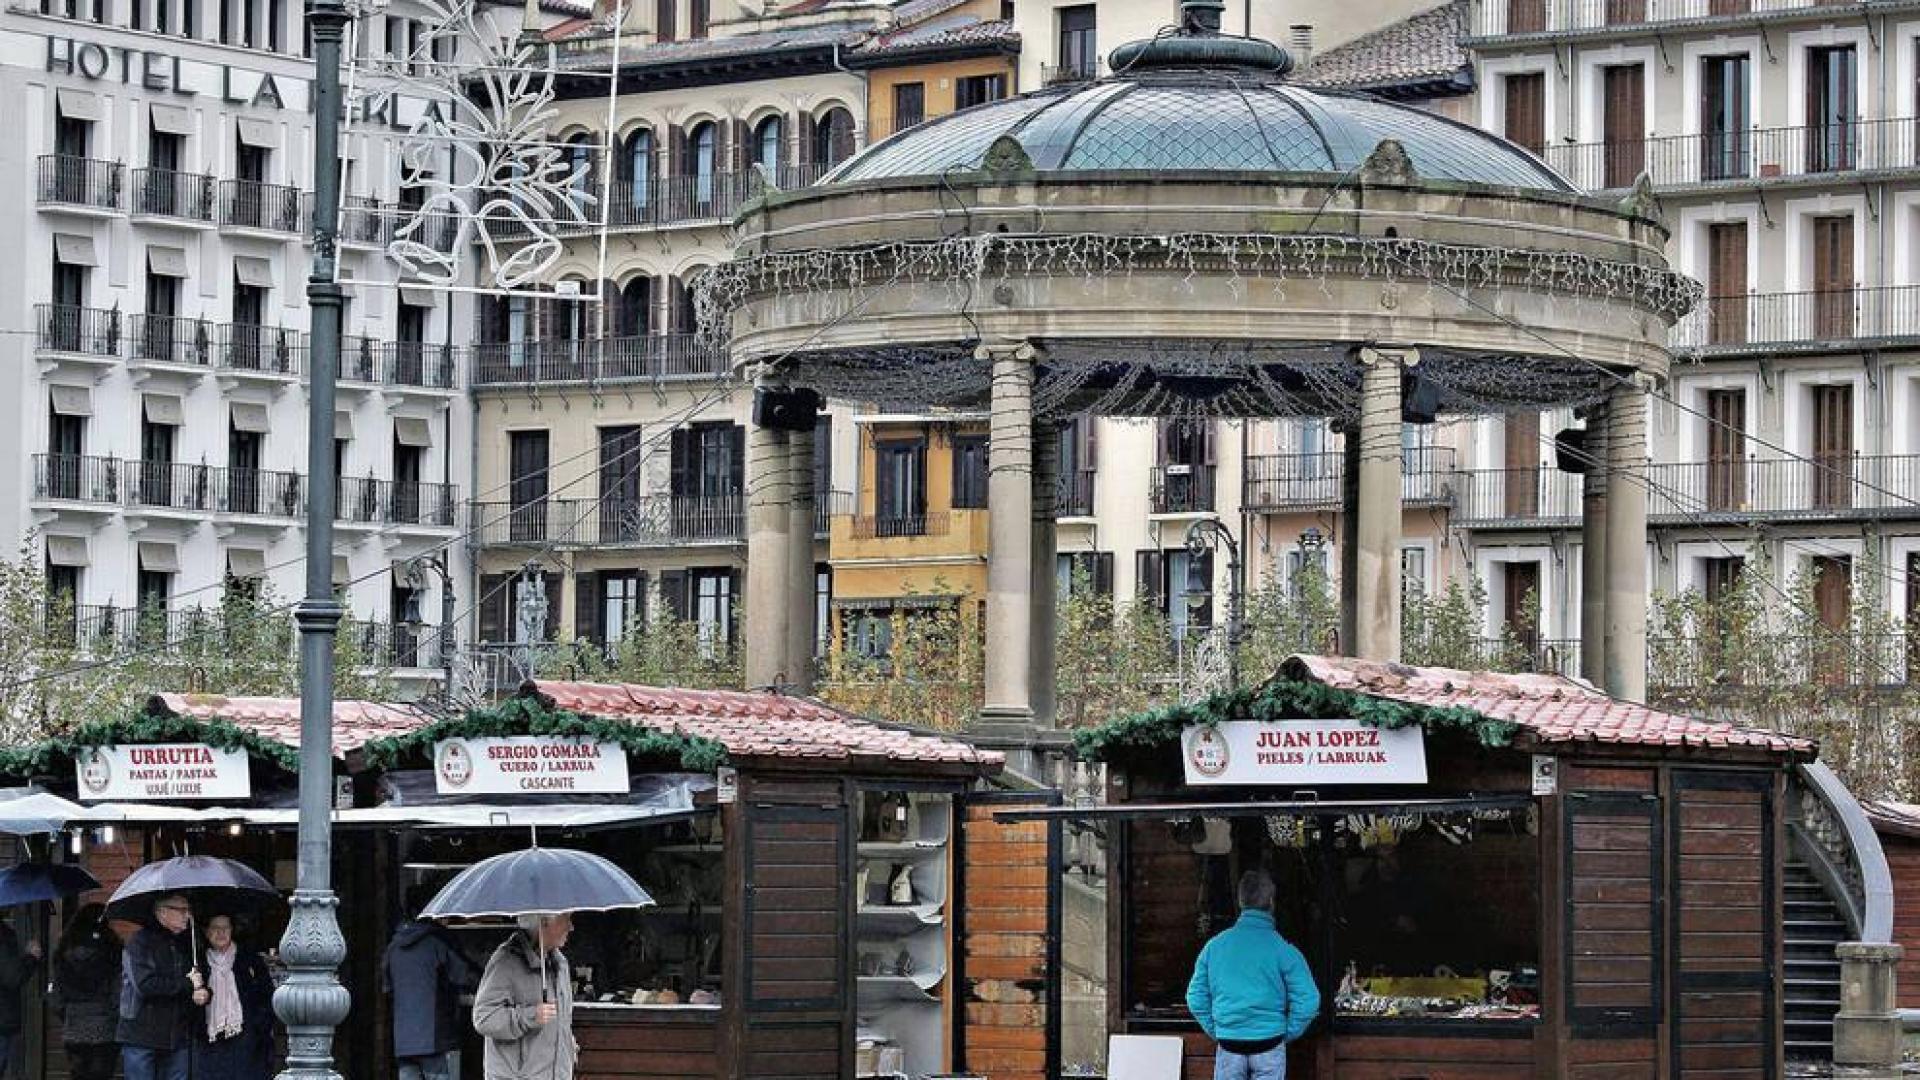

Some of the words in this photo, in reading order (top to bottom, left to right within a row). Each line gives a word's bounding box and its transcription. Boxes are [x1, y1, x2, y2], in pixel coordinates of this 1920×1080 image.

[46, 35, 198, 96] HOTEL
[222, 65, 285, 109] LA
[1256, 732, 1311, 747] JUAN
[130, 747, 213, 764] URRUTIA
[487, 745, 537, 759] SERGIO
[1257, 752, 1304, 764] PIELES
[1317, 751, 1387, 763] LARRUAK
[499, 761, 538, 772] CUERO
[548, 761, 595, 772] LARRUA
[129, 769, 167, 780] PASTAS
[176, 768, 217, 779] PASTAK
[519, 777, 575, 790] CASCANTE
